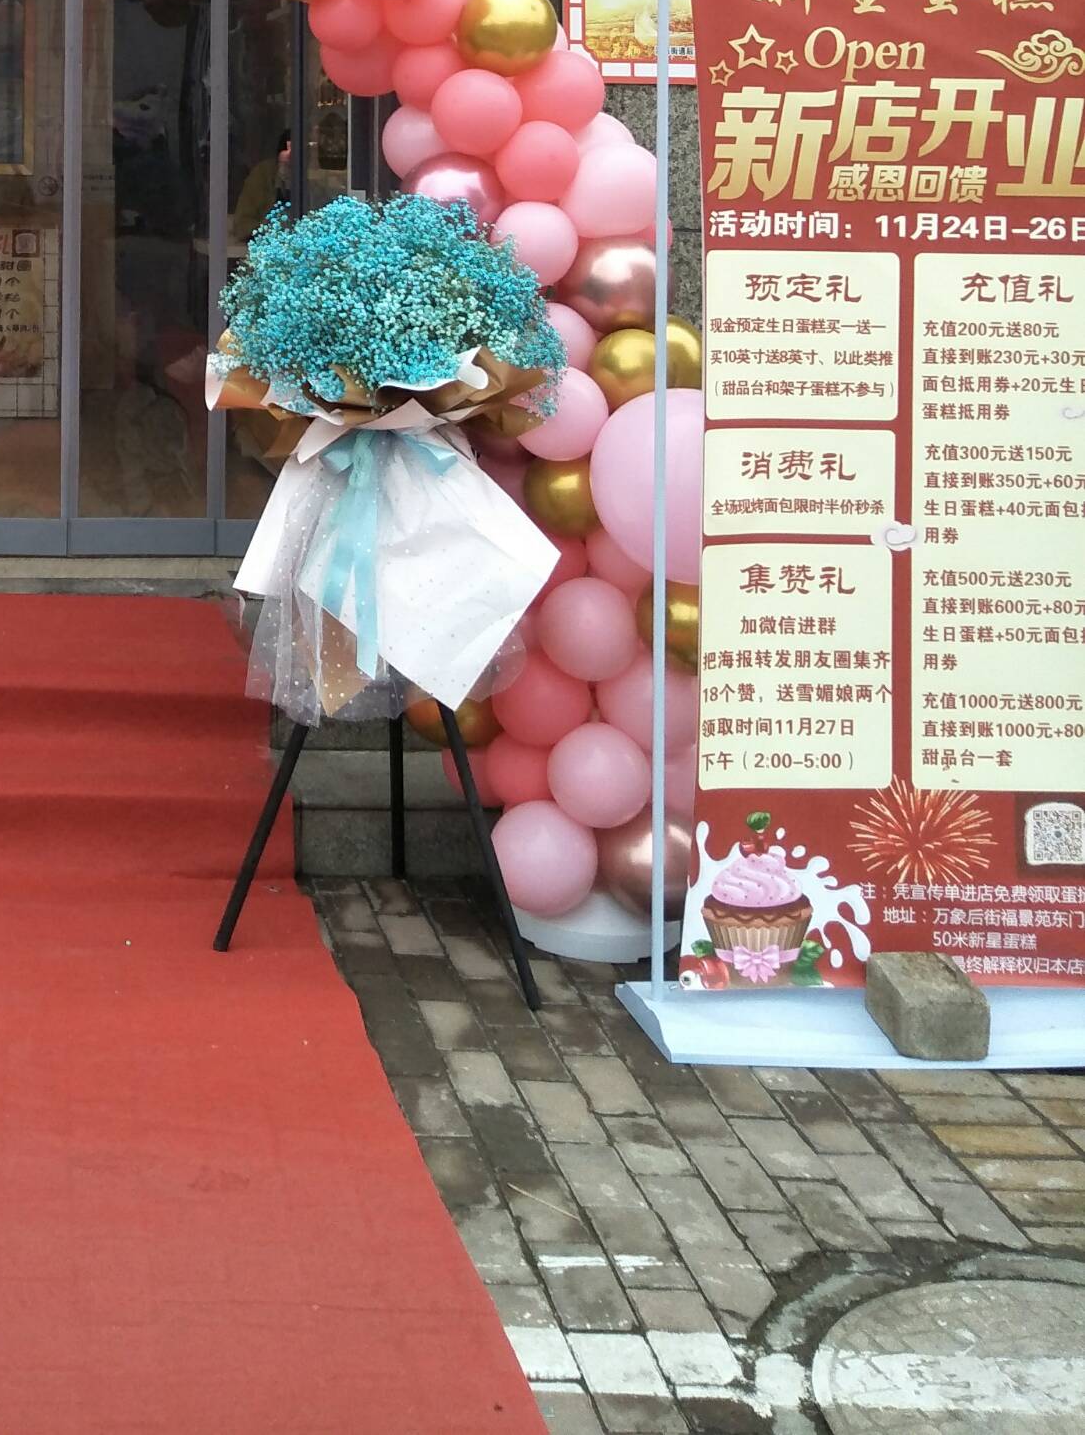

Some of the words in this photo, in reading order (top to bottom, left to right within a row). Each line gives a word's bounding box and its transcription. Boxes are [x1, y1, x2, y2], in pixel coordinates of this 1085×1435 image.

[803, 25, 926, 83] Open
[707, 77, 1085, 202] 新店开业
[827, 163, 988, 204] 感恩回馈
[745, 272, 863, 303] 预定礼
[960, 272, 1075, 303] 充值礼
[710, 316, 887, 335] 现金预定生日蛋糕买一送一
[922, 320, 1060, 339] 充值200元送80元
[922, 403, 1011, 421] 蛋糕抵用券
[923, 444, 1073, 463] 充值300元送150元
[741, 450, 857, 481] 消费礼
[711, 498, 885, 516] 全场现烤面包限时半价秒杀
[923, 499, 1085, 518] 生日蛋糕+40元面包
[923, 526, 959, 545] 用券
[739, 562, 856, 595] 集赞礼
[922, 569, 1073, 588] 充值500元送230元
[739, 615, 837, 636] 加微信进群
[922, 626, 1085, 645] 生日蛋糕+50元面包
[703, 649, 891, 670] 把海报转发朋友圈集齐
[922, 653, 958, 671] 用券
[922, 693, 1084, 711] 充值1000元送800元
[702, 717, 855, 738] 领取时间11月27日
[921, 719, 1085, 739] 直接到账1000元+80
[921, 748, 1013, 767] 甜品台一套
[932, 931, 1037, 950] 50米新星蛋糕
